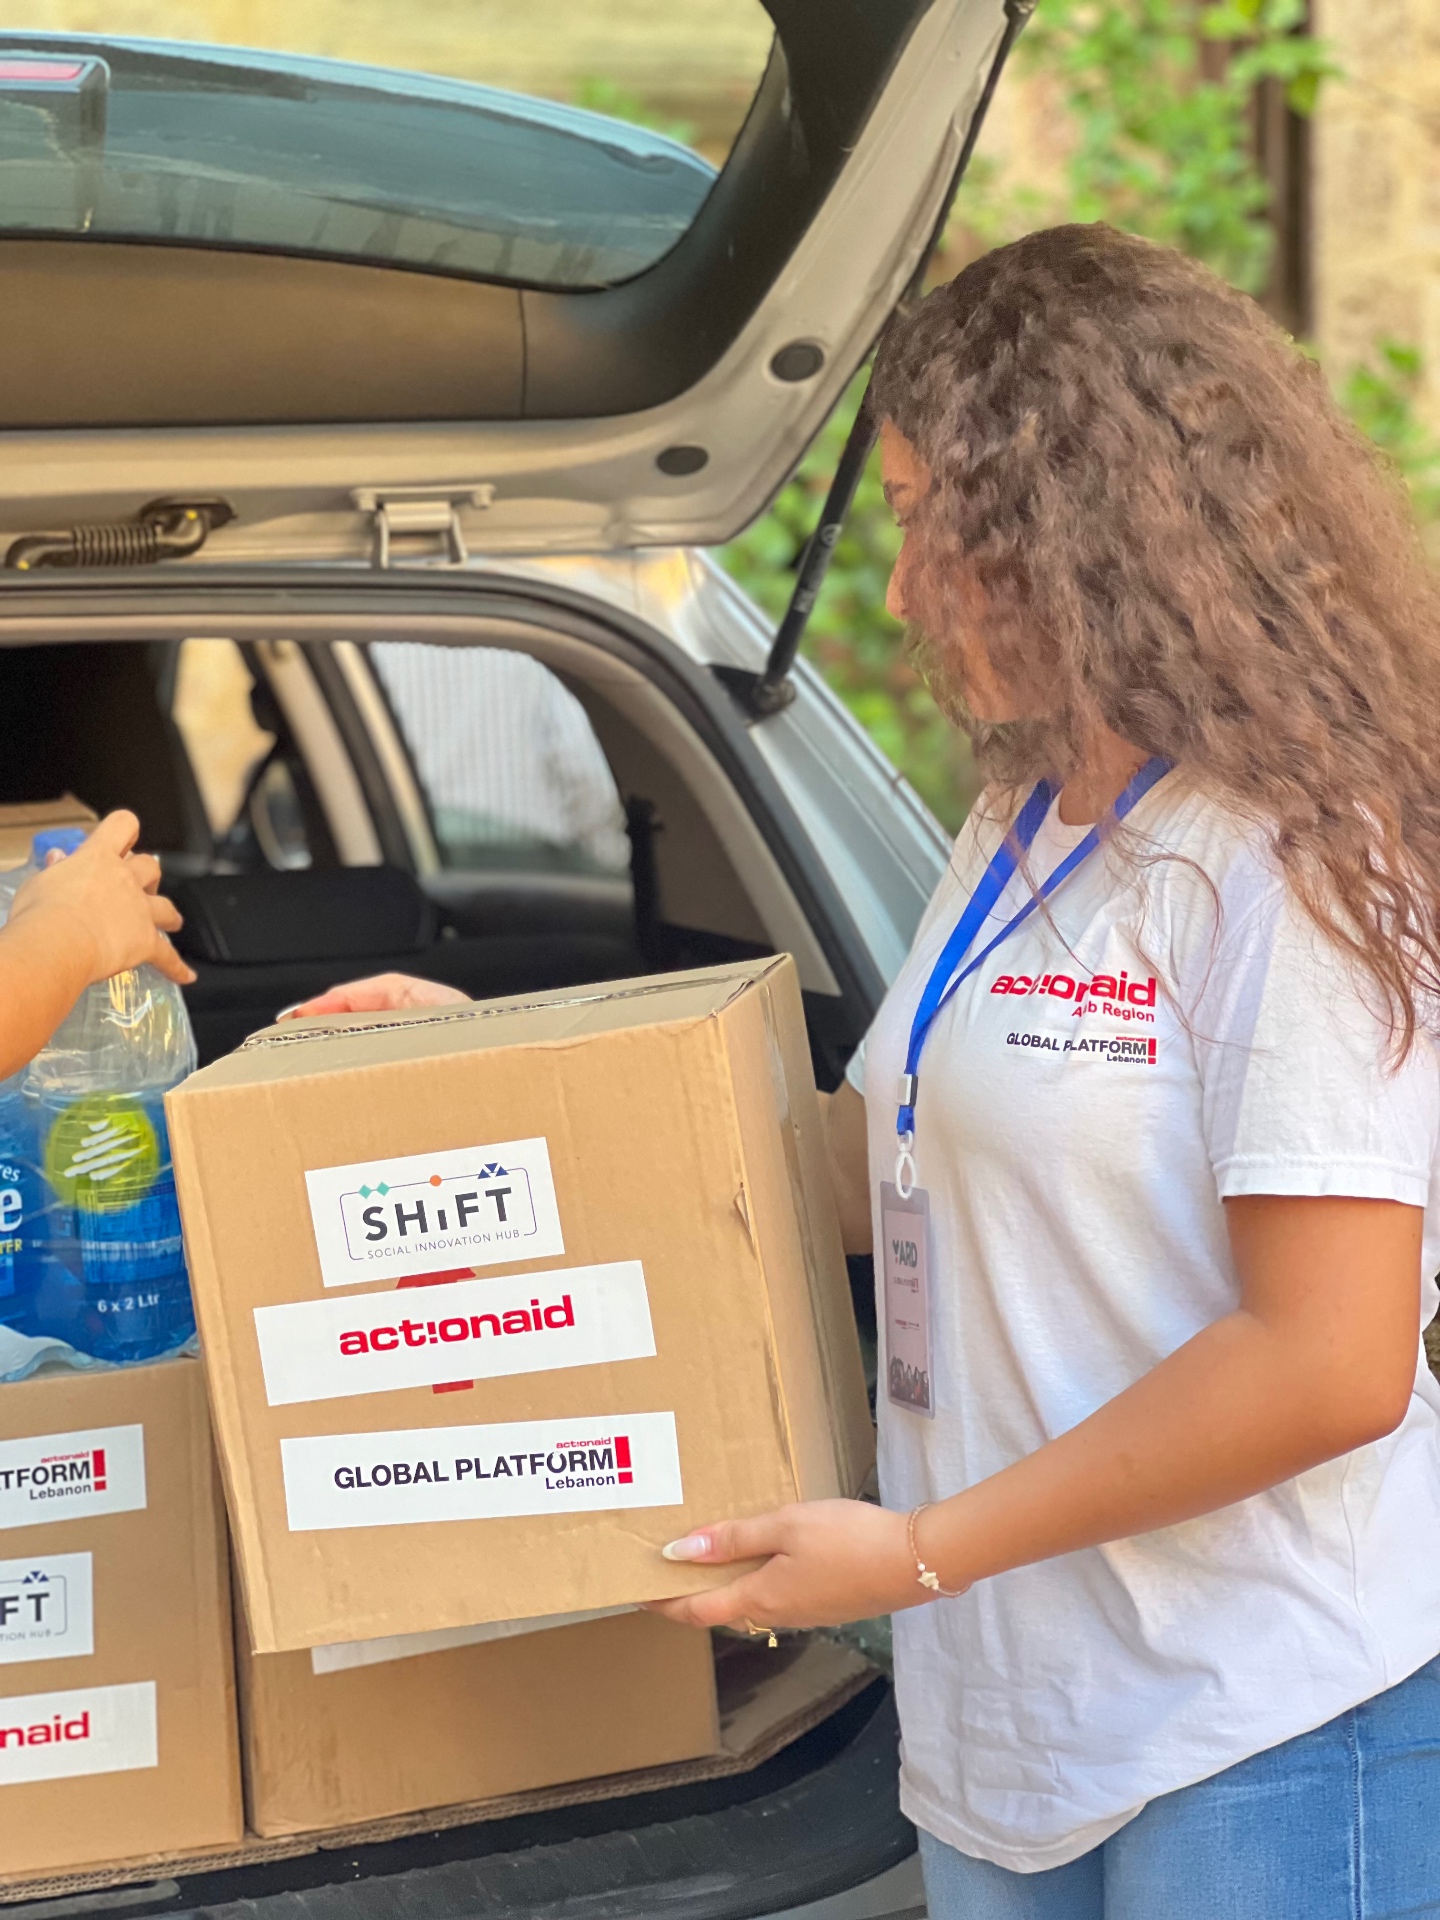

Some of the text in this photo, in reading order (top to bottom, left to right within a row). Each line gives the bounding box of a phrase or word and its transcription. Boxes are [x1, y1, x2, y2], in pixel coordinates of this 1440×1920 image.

[1103, 1002, 1155, 1023] Region
[1006, 1032, 1060, 1051] GLOBAL
[1106, 1053, 1147, 1064] Lebanon
[367, 1229, 521, 1260] SOCIAL INNOVATION HUB
[97, 1294, 160, 1313] 6 x 2 Ltr
[334, 1460, 449, 1490] GLOBAL
[545, 1473, 616, 1490] Lebanon
[29, 1484, 92, 1500] Lebanon
